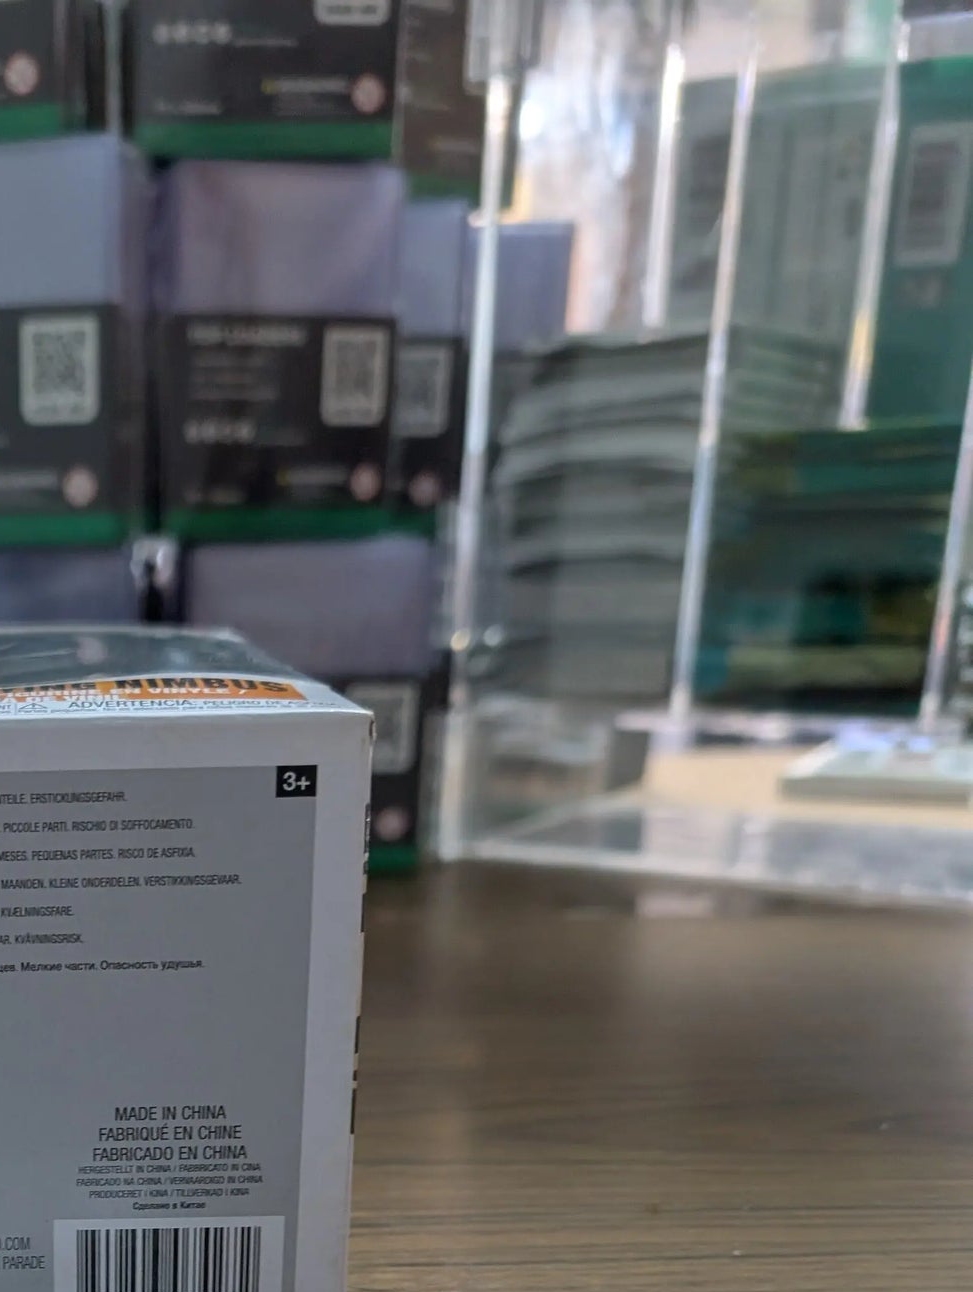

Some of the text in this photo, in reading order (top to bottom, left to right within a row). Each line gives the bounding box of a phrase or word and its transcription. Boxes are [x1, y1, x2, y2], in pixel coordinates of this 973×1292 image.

[115, 677, 287, 692] NIMBUS
[282, 771, 311, 791] 3+
[114, 1104, 227, 1121] MADE IN CHINA
[98, 1122, 242, 1142] FABRIQUÉ EN CHINE
[93, 1144, 248, 1162] FABRICADO EN CHINA
[3, 1255, 45, 1270] PARADE
